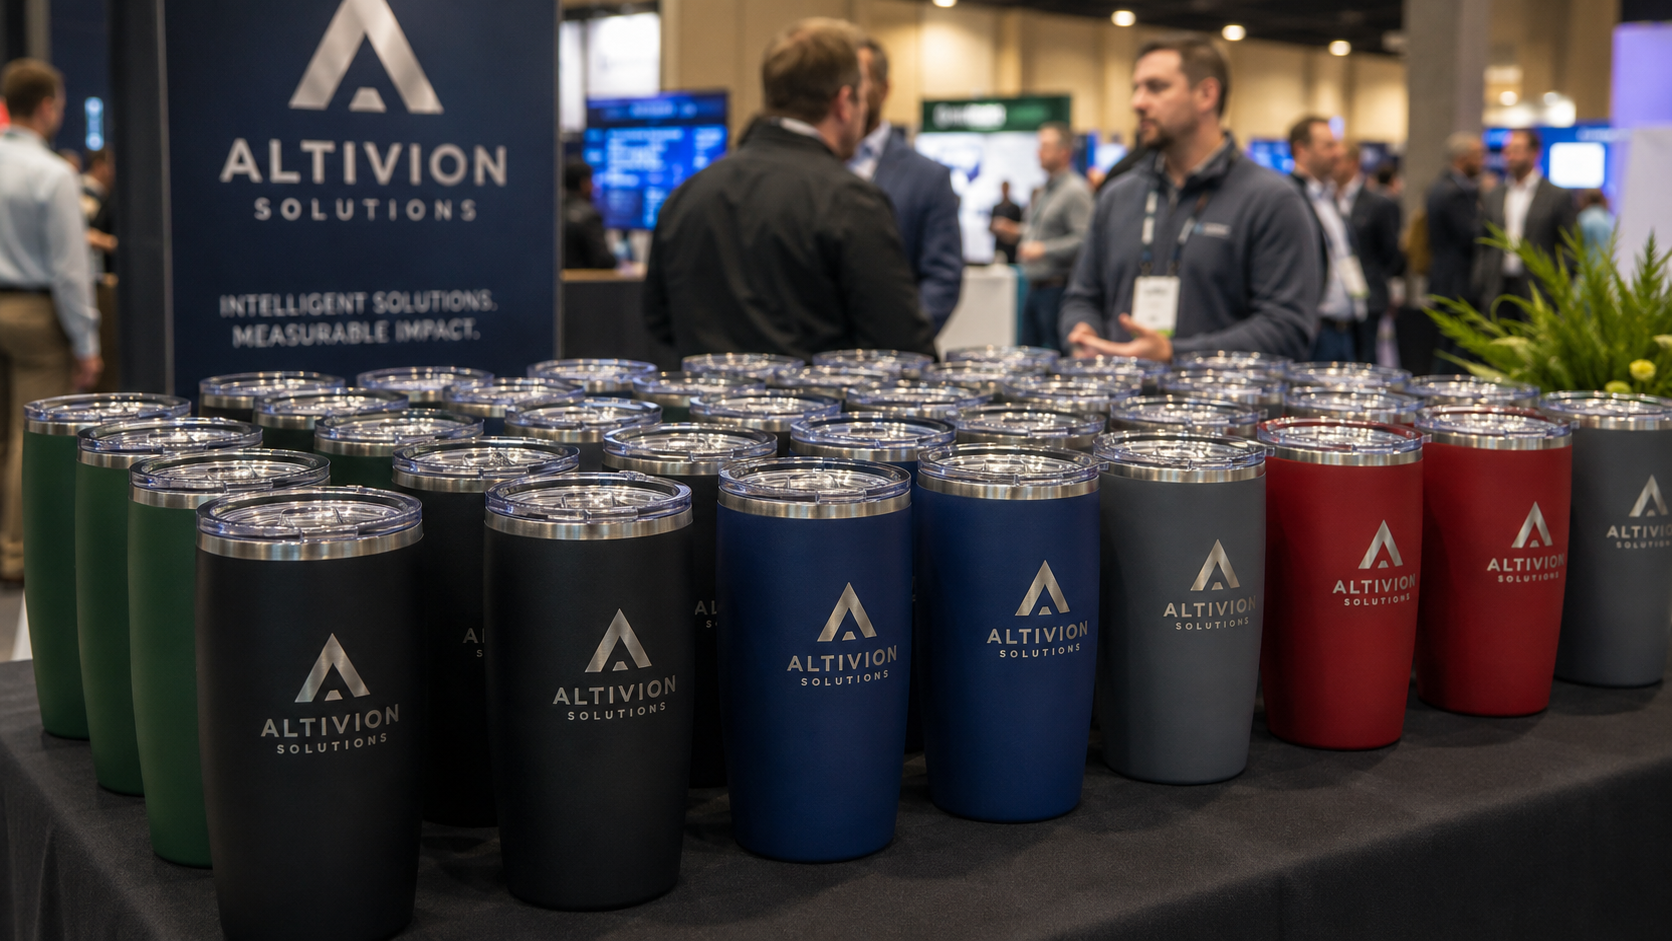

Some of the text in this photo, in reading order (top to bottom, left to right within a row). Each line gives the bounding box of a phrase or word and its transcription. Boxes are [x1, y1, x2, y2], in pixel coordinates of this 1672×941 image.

[219, 138, 508, 187] ALTIVION
[254, 197, 477, 221] SOLUTIONS
[219, 289, 499, 318] INTELLIGENT SOLUTIONS.
[232, 317, 481, 348] MEASURABLE IMPACT.
[1606, 523, 1672, 538] ALTIVIO
[1486, 553, 1565, 572] ALTIVION
[1332, 573, 1416, 595] ALTIVION
[1163, 595, 1256, 618] ALTIVION
[1344, 593, 1411, 606] SOLUTIONS
[986, 620, 1089, 645] ALTIVION
[1175, 616, 1249, 631] SOLUTIONS
[786, 645, 897, 672] ALTIVION
[999, 643, 1081, 659] SOLUTIONS
[801, 670, 889, 686] SOLUTIONS
[552, 675, 676, 705] ALTIVION
[260, 704, 399, 737] ALTIVION
[567, 702, 666, 720] SOLUTIONS
[276, 733, 387, 754] SOLUTIONS
